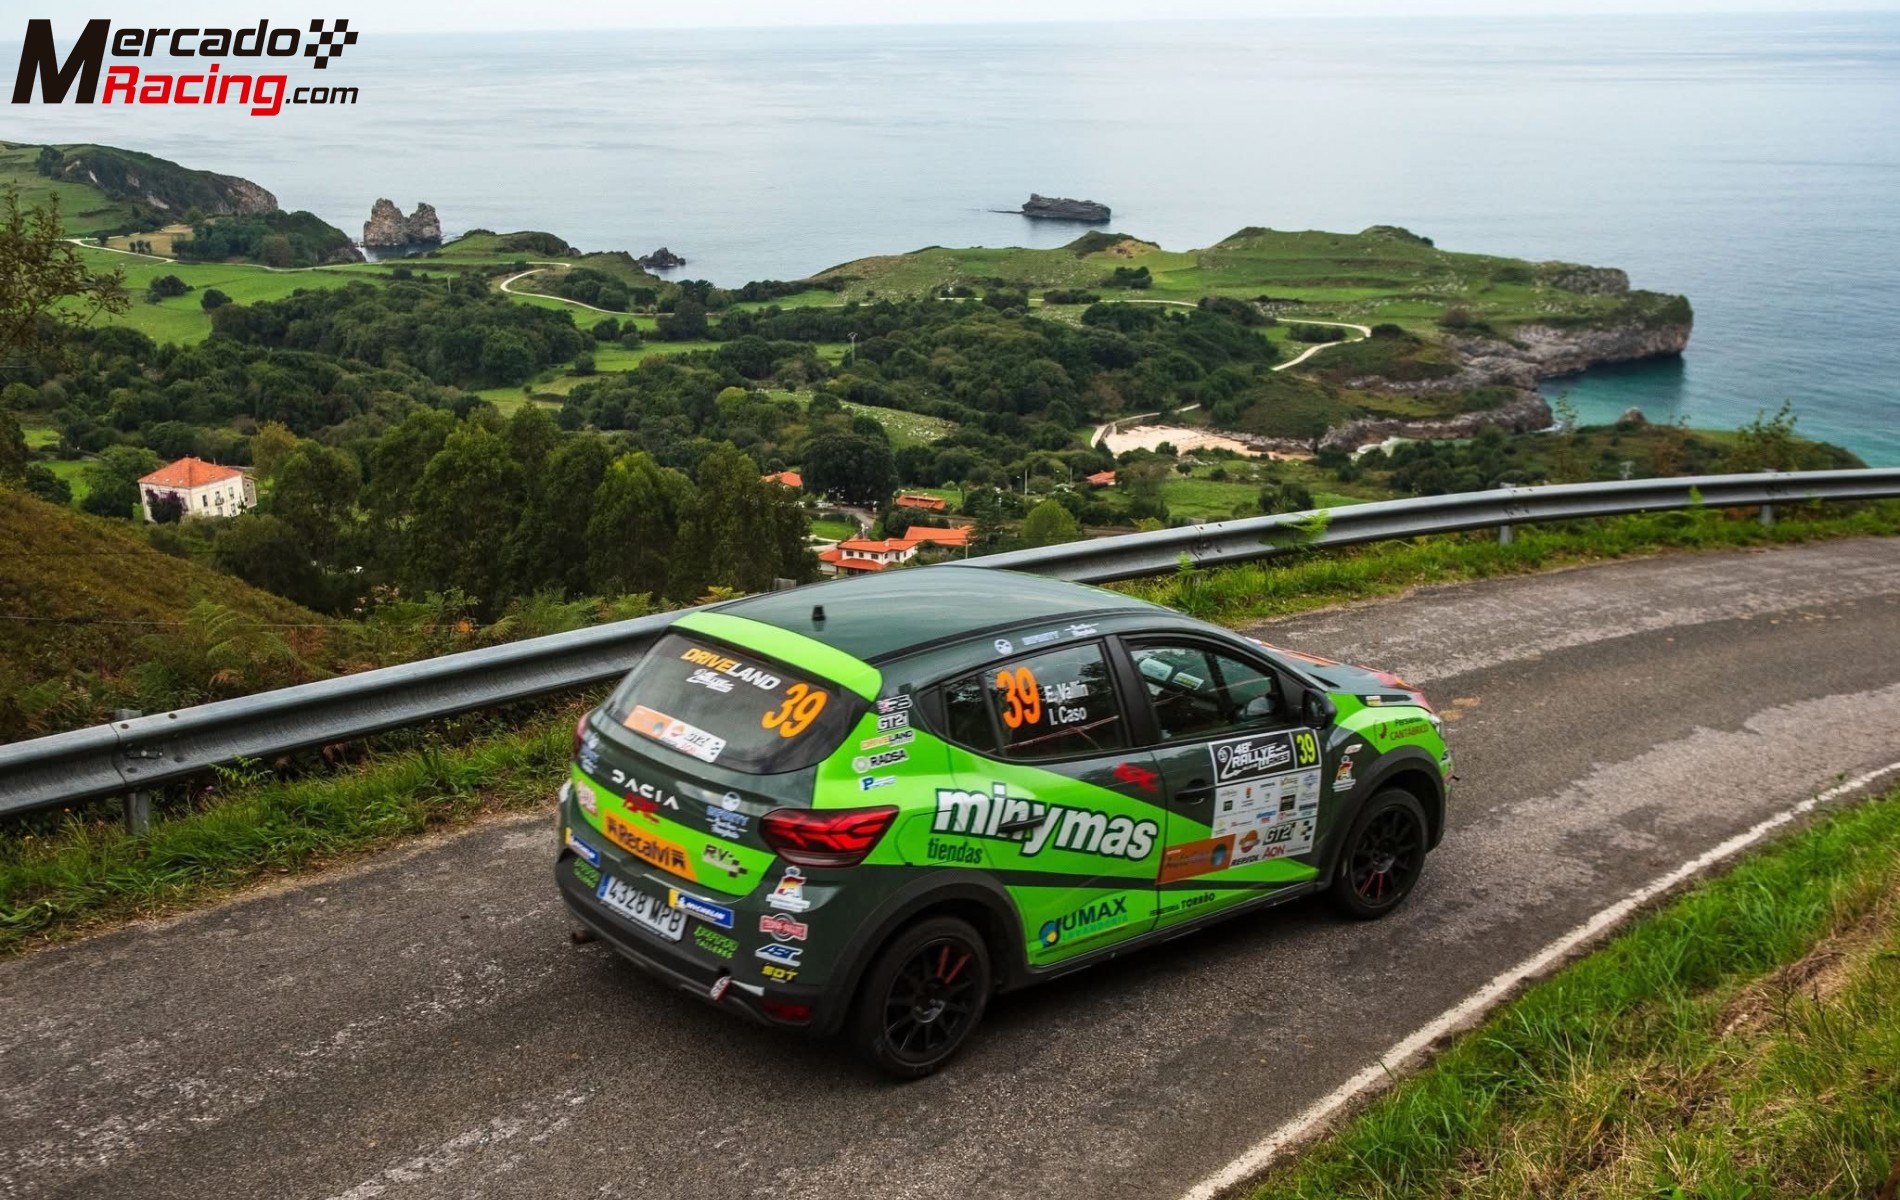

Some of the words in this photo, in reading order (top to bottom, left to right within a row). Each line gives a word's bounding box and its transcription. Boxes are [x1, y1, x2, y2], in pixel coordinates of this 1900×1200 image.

[680, 648, 781, 690] DRIVELAND
[761, 683, 828, 737] 39
[995, 666, 1041, 728] 39
[1058, 706, 1088, 723] Caso
[1296, 733, 1316, 764] 39
[611, 769, 680, 811] DACIA
[932, 783, 1157, 859] minymas
[927, 837, 983, 865] tiendas
[609, 876, 644, 914] 4328
